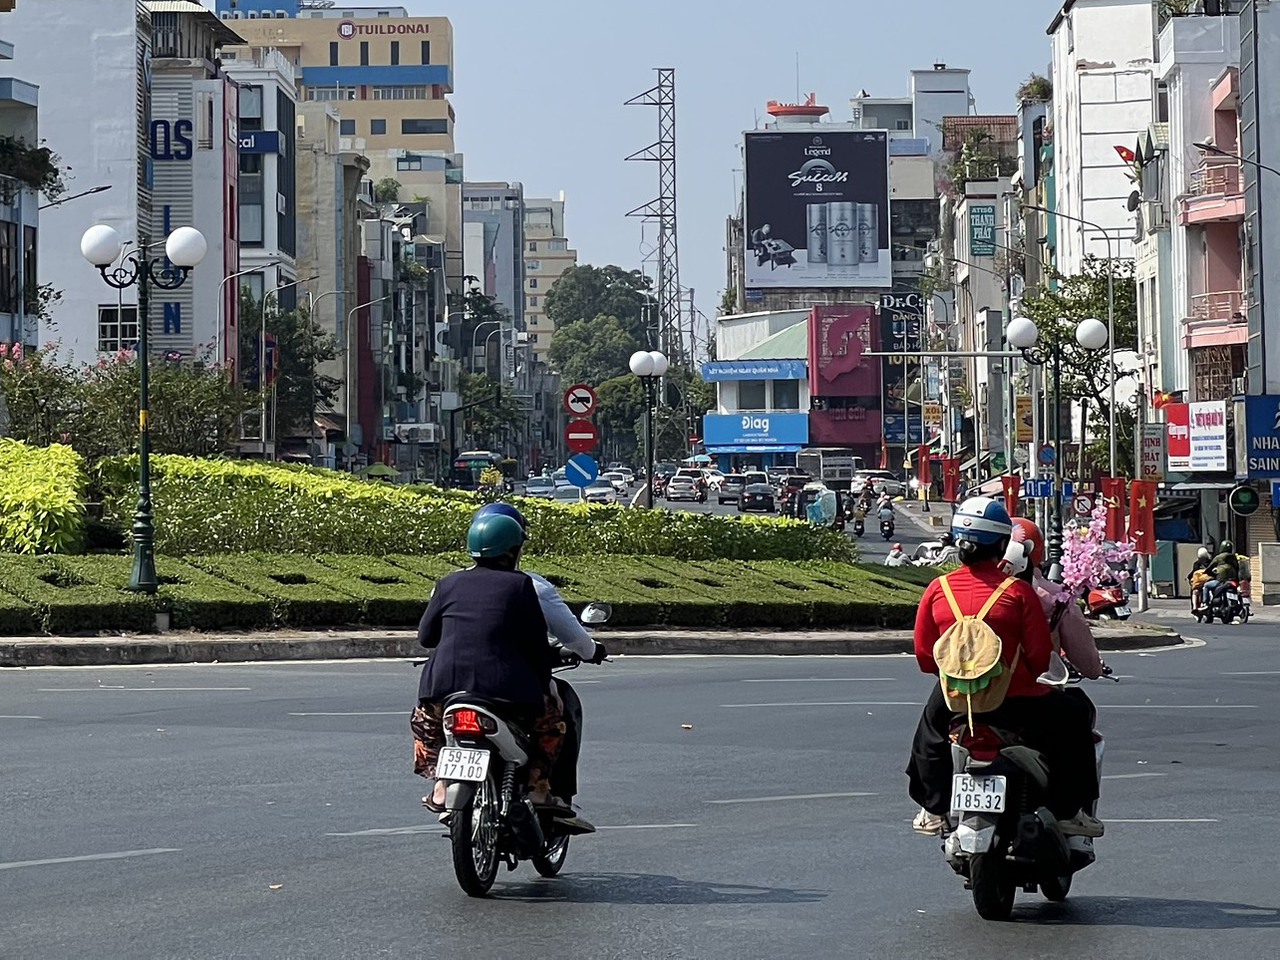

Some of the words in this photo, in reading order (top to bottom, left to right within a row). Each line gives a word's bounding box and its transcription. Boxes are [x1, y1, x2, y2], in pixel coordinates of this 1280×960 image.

[804, 147, 831, 157] Legend
[741, 416, 770, 433] Diag
[447, 751, 483, 765] 59-H2
[443, 764, 483, 779] 171.00
[961, 778, 996, 793] 59-F1
[956, 794, 1002, 810] 185.32
